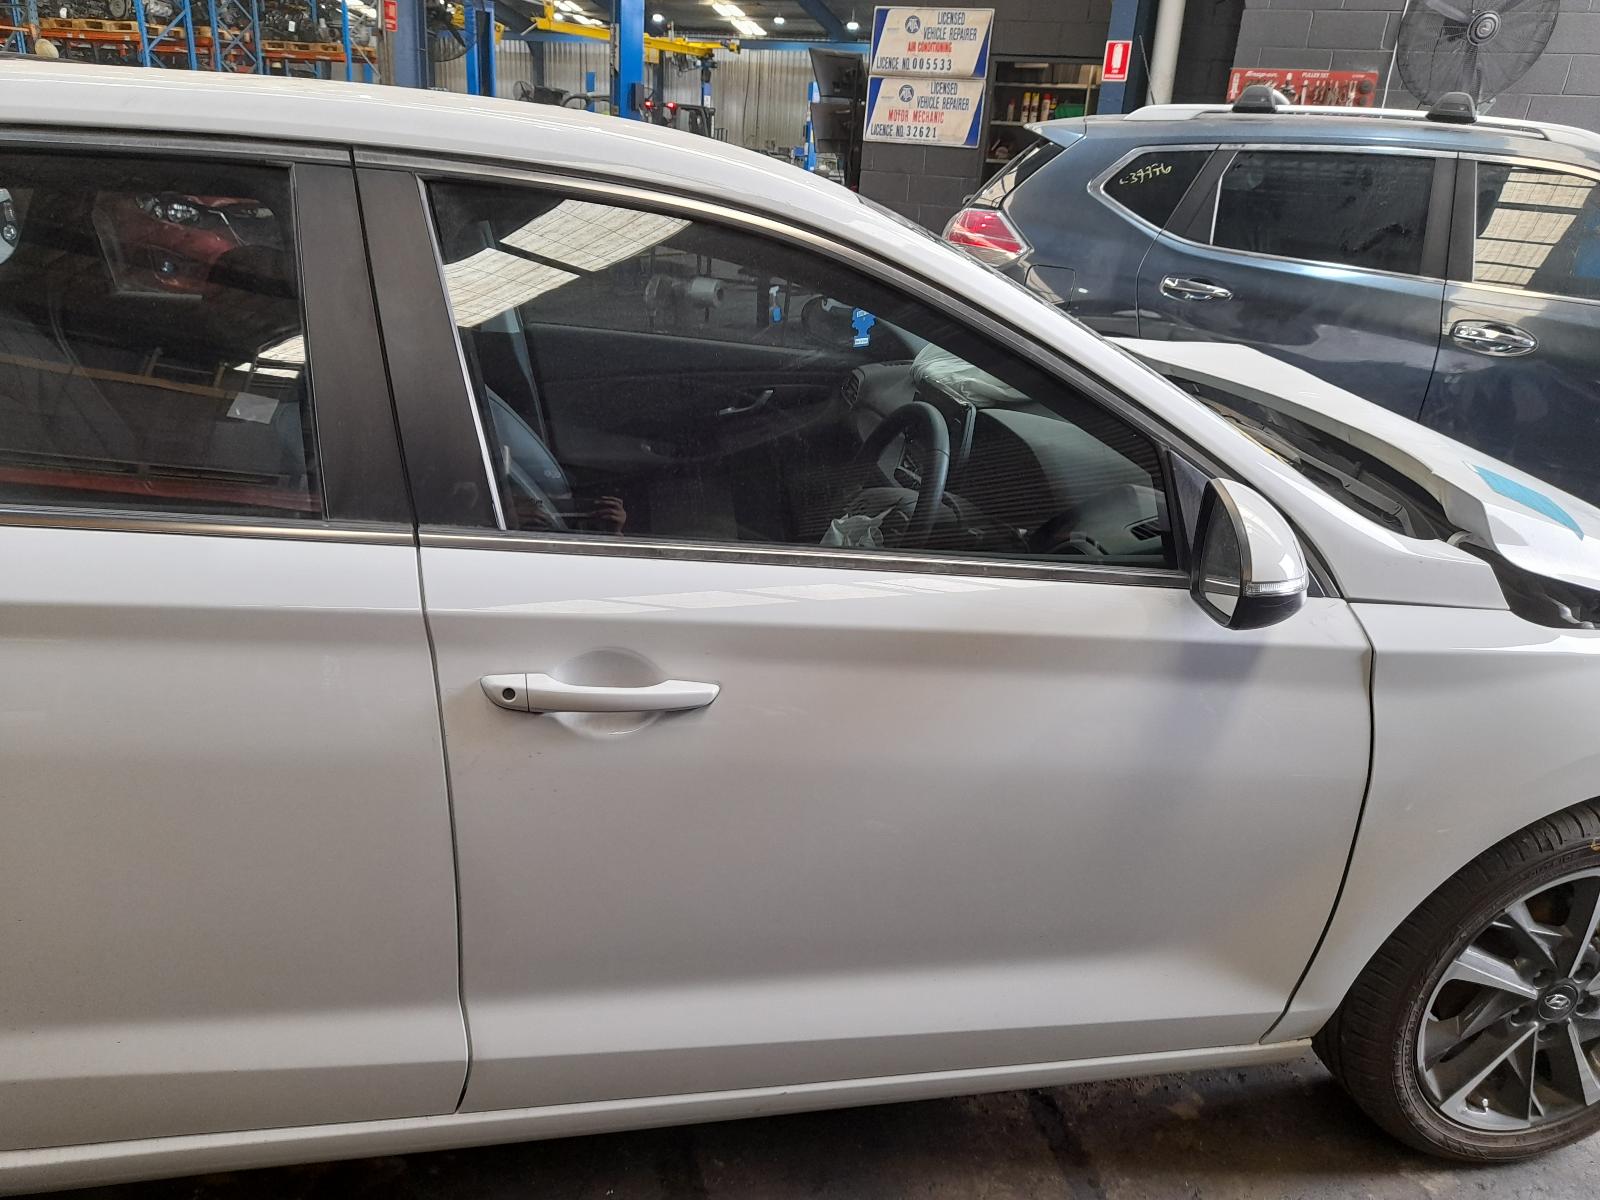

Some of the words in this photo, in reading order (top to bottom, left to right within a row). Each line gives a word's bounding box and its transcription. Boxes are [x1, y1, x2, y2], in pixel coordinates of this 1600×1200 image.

[937, 11, 966, 26] LICENSED
[923, 27, 947, 40] VEHICLE
[949, 27, 978, 41] REPAIRER
[907, 41, 917, 52] AIR
[918, 42, 952, 53] CONDITIONING
[876, 56, 900, 70] LICENCE
[930, 81, 959, 96] LICENSED
[916, 95, 940, 109] VEHICLE
[941, 97, 970, 111] REPAIRER
[888, 108, 909, 122] MOTOR
[912, 110, 945, 124] MECHANIC
[870, 123, 894, 138] LICENCE
[906, 125, 937, 138] 32621
